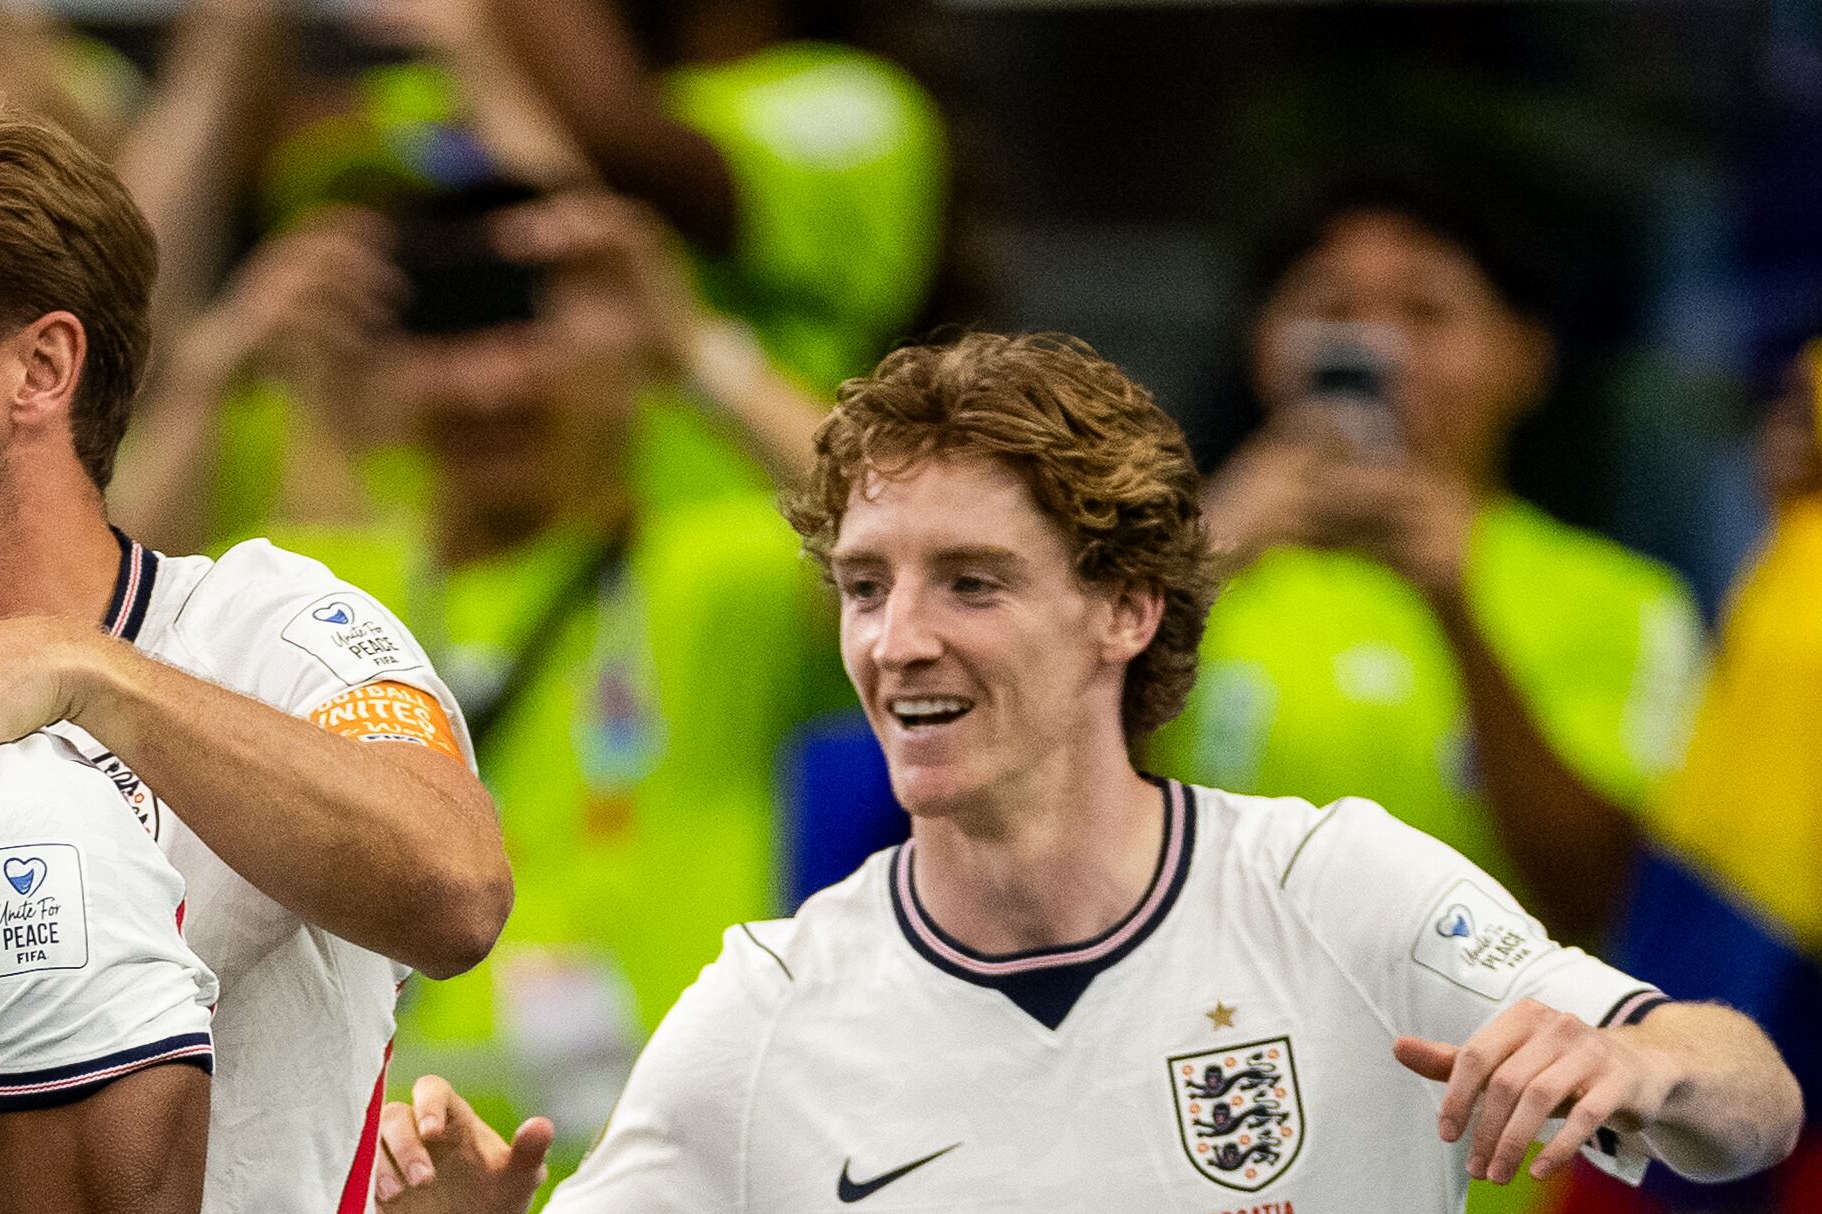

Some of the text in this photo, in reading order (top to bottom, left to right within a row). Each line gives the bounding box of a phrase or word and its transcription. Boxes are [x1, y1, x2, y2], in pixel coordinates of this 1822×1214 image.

[348, 636, 400, 660] PEACE
[372, 655, 400, 667] FIFA
[317, 686, 431, 712] OOTBALL
[36, 896, 62, 920] For
[2, 921, 60, 951] PEACE
[16, 949, 48, 965] FIFA
